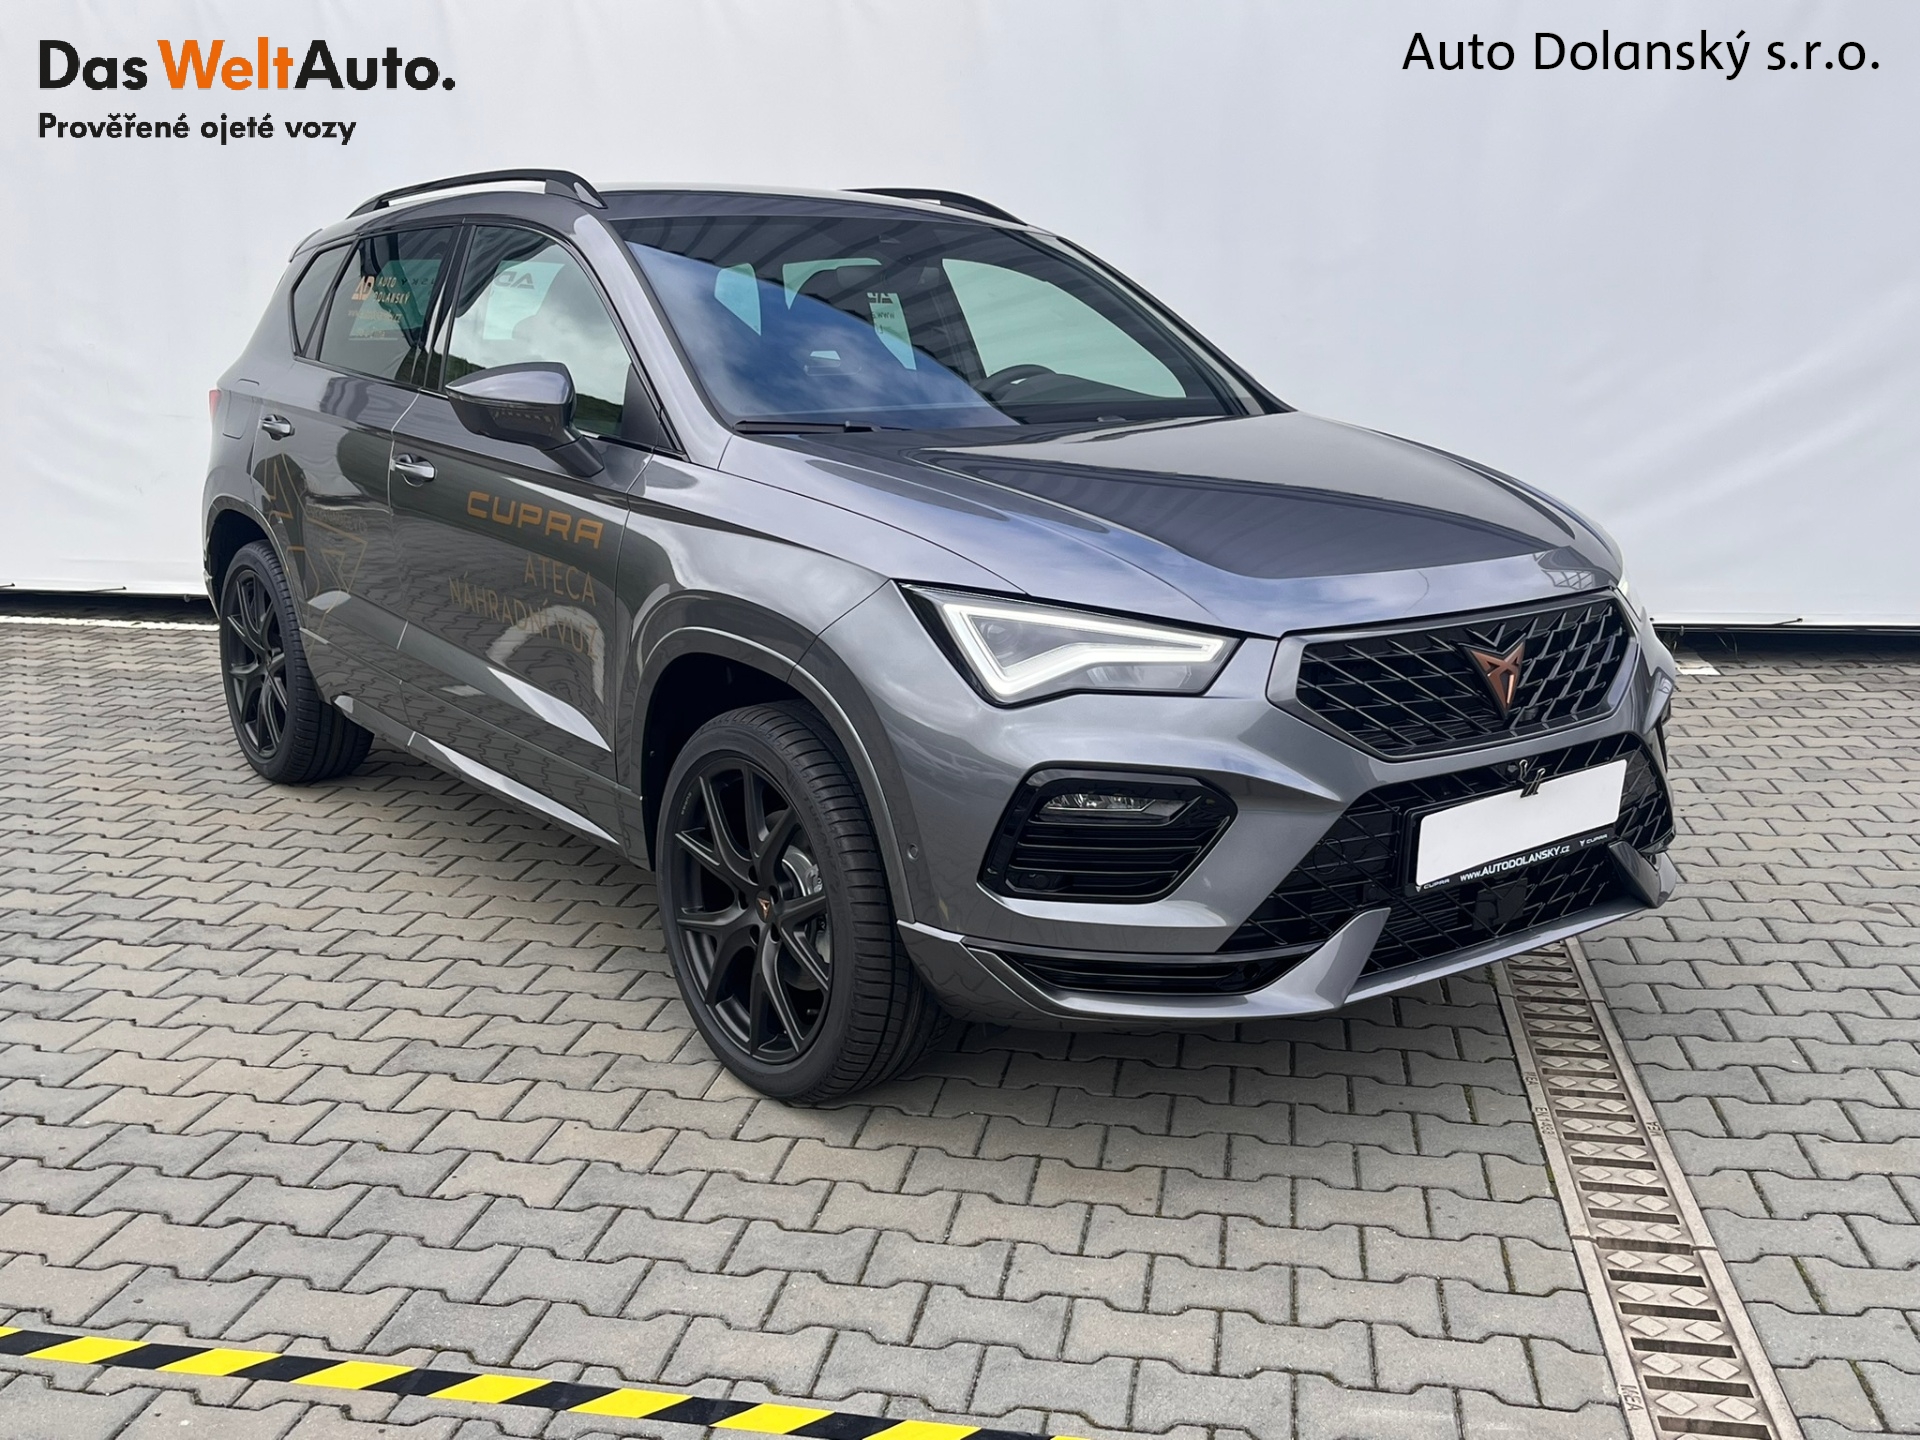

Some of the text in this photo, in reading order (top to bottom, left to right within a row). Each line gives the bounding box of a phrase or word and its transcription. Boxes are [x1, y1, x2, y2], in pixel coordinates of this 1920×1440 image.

[378, 276, 397, 288] AUTO
[467, 491, 604, 549] CUPRA
[448, 571, 550, 640] NÁHRADNÍ
[523, 554, 597, 606] ATECA
[1460, 845, 1571, 883] www.AUTODOLANSKY.cz
